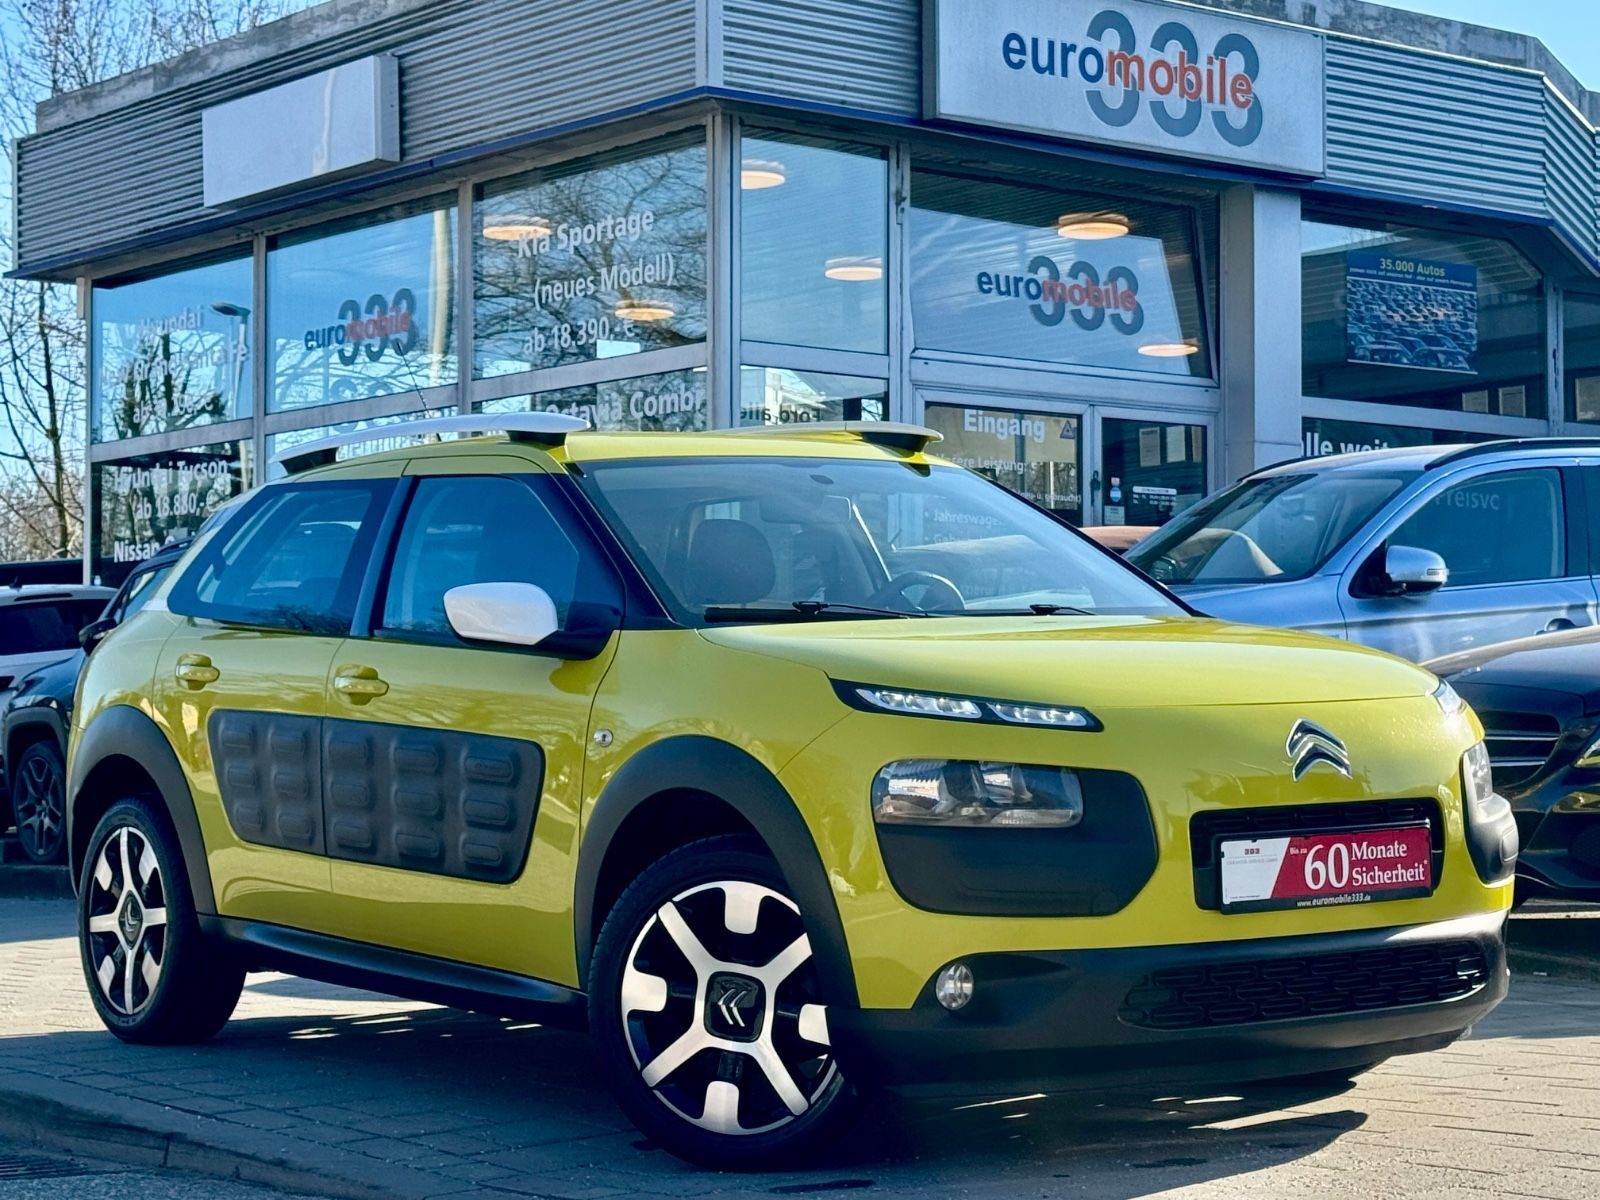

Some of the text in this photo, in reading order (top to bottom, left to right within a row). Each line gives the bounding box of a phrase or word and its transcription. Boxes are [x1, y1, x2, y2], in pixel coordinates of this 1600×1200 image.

[1002, 32, 1253, 110] euromobile
[1084, 10, 1263, 147] 333
[556, 210, 655, 255] Sportage
[534, 252, 675, 311] (neues Modell)
[1380, 258, 1415, 273] 35.000
[1417, 263, 1446, 277] Autos
[977, 270, 1137, 312] euromobile
[523, 327, 545, 354] ab
[964, 408, 1045, 443] Eingang
[177, 459, 228, 482] Tucson
[136, 494, 152, 519] ab
[114, 539, 160, 563] Nissan
[1304, 842, 1349, 890] 60
[1351, 840, 1408, 861] Monate
[1296, 892, 1371, 907] www.euromobile333.de
